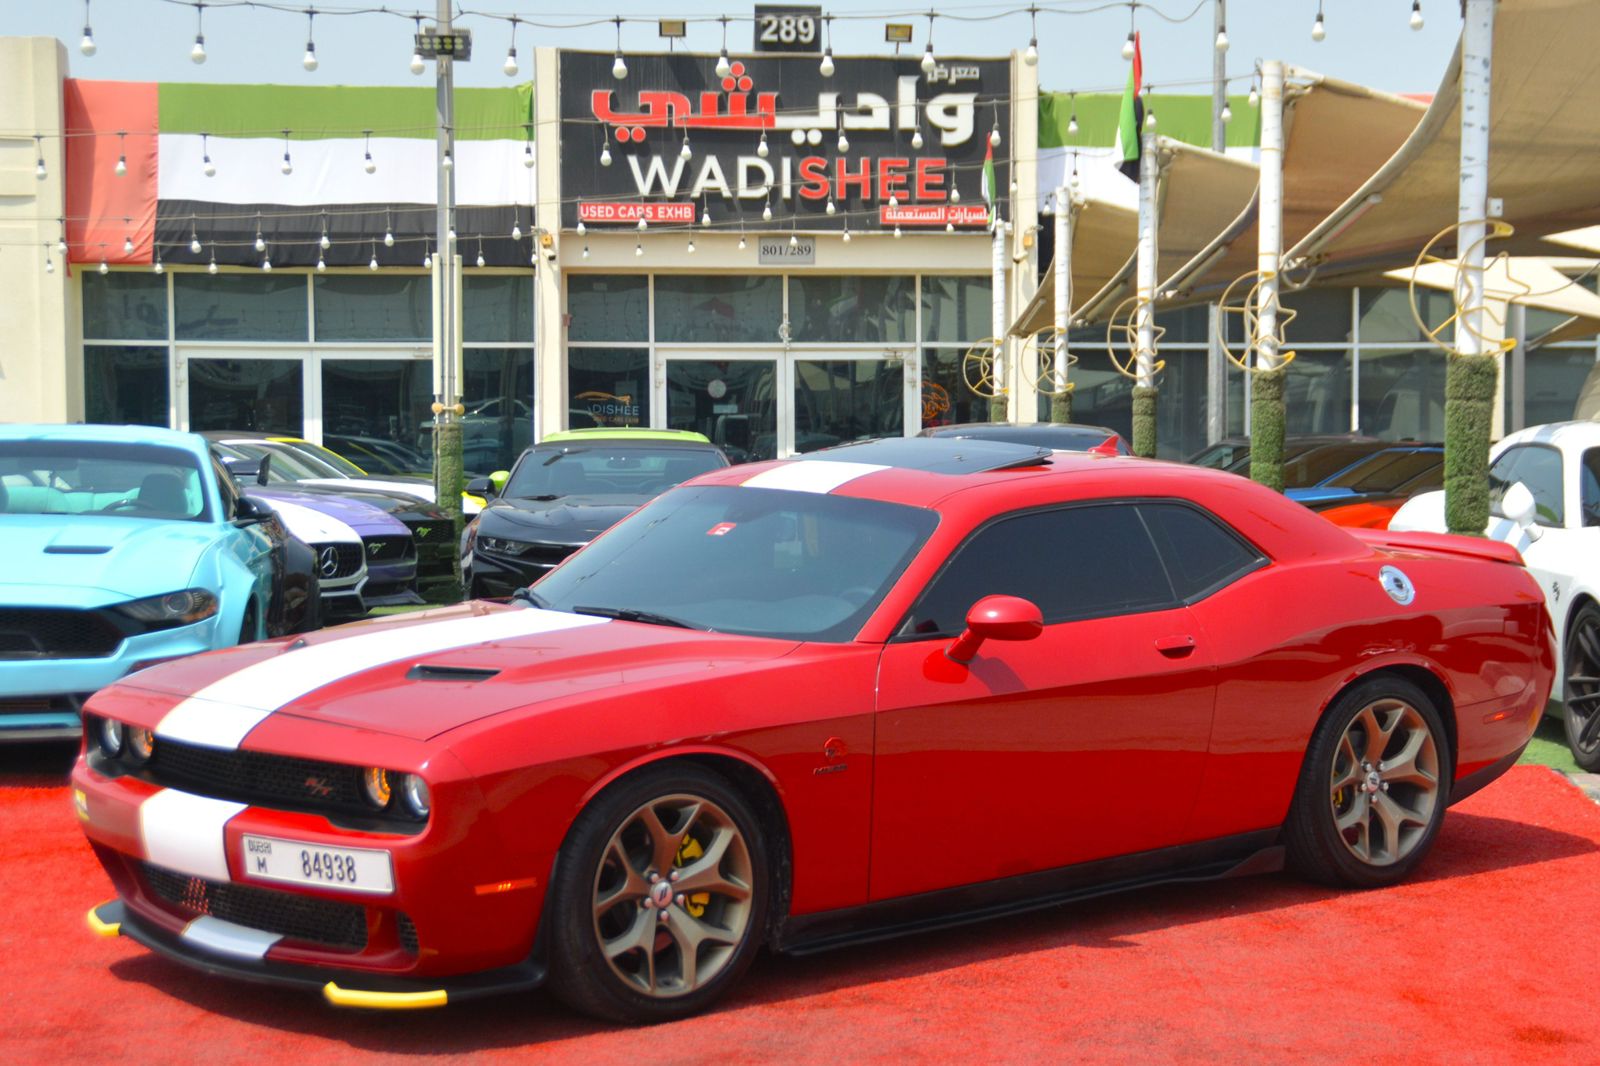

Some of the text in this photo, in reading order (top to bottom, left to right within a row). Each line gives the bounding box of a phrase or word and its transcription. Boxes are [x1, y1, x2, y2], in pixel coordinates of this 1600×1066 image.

[760, 14, 817, 45] 289
[627, 154, 948, 201] WADISHEE
[580, 205, 614, 218] USED
[657, 206, 693, 219] EXHB
[762, 244, 812, 256] 801/289
[256, 849, 357, 884] M 84938
